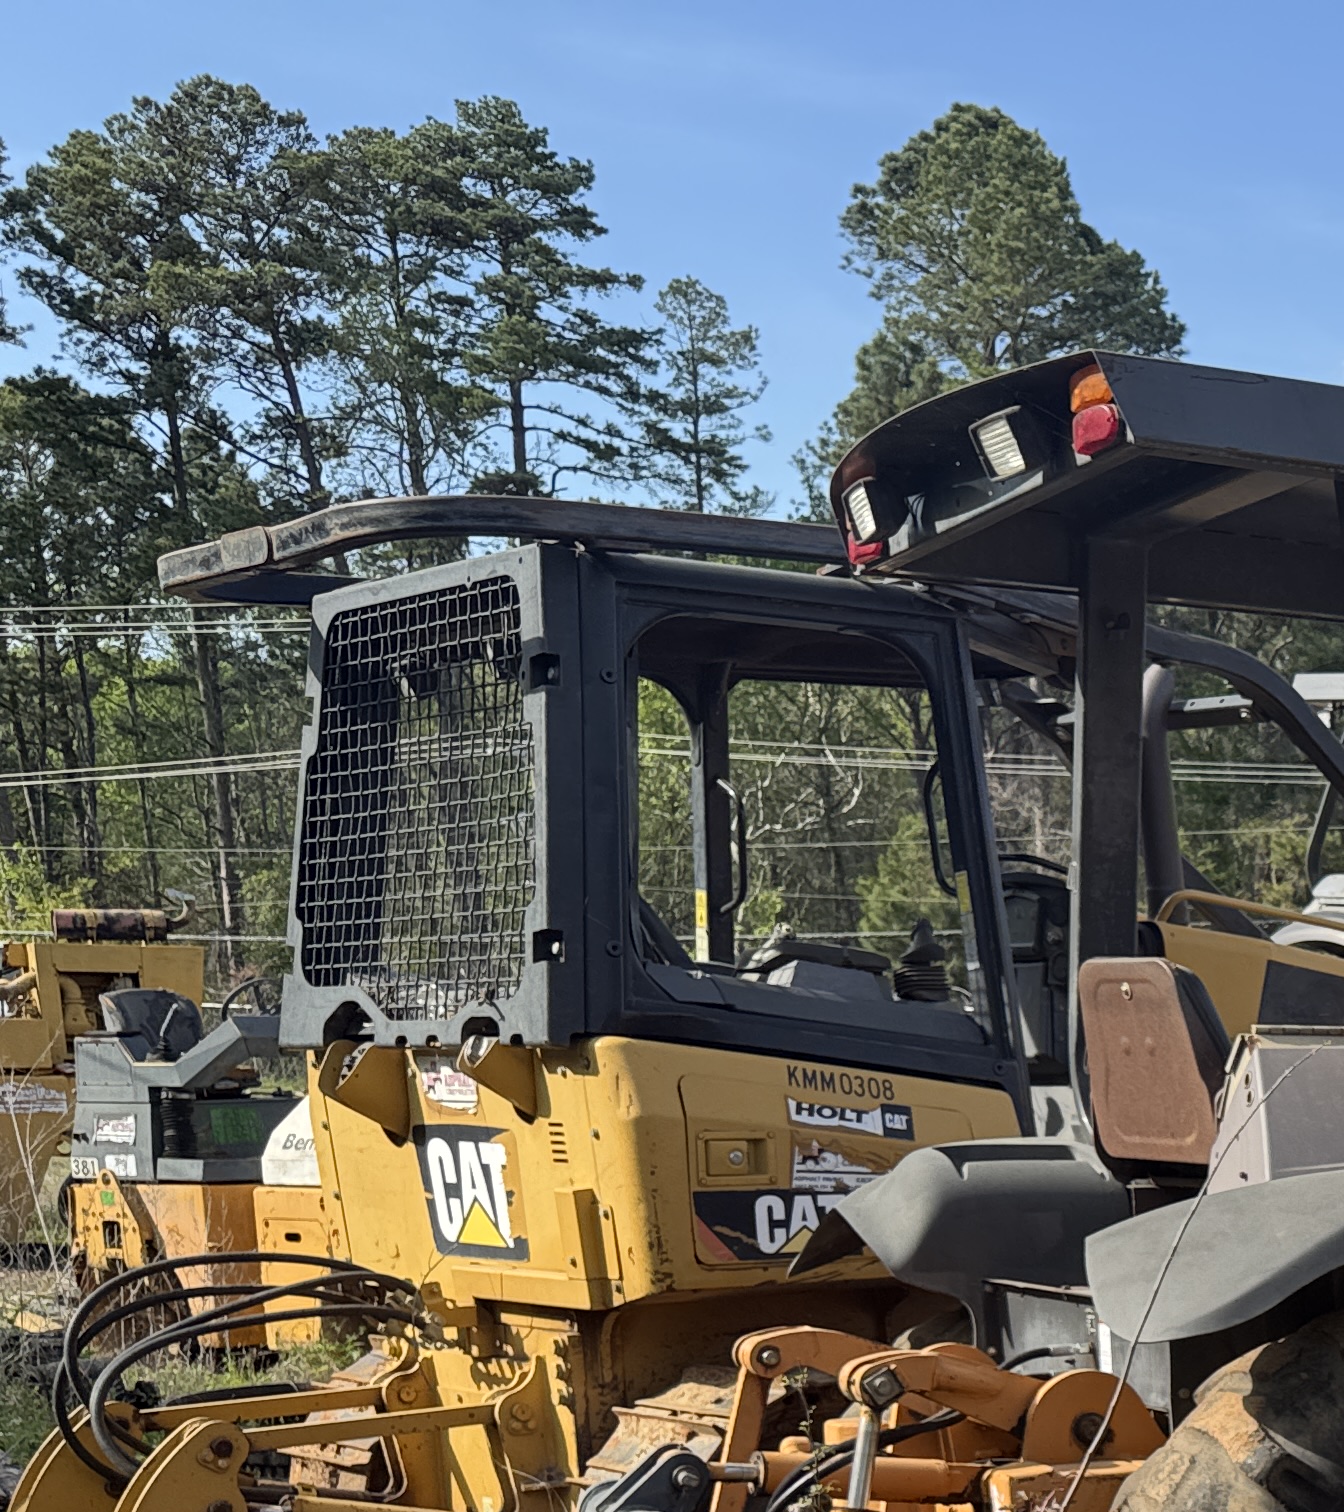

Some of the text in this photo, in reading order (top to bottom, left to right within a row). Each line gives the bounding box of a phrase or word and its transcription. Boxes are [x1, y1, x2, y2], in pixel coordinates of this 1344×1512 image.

[786, 1064, 895, 1101] KMM0308
[795, 1101, 911, 1131] HOLT CAT
[73, 1158, 97, 1177] 381
[426, 1136, 516, 1249] CAT
